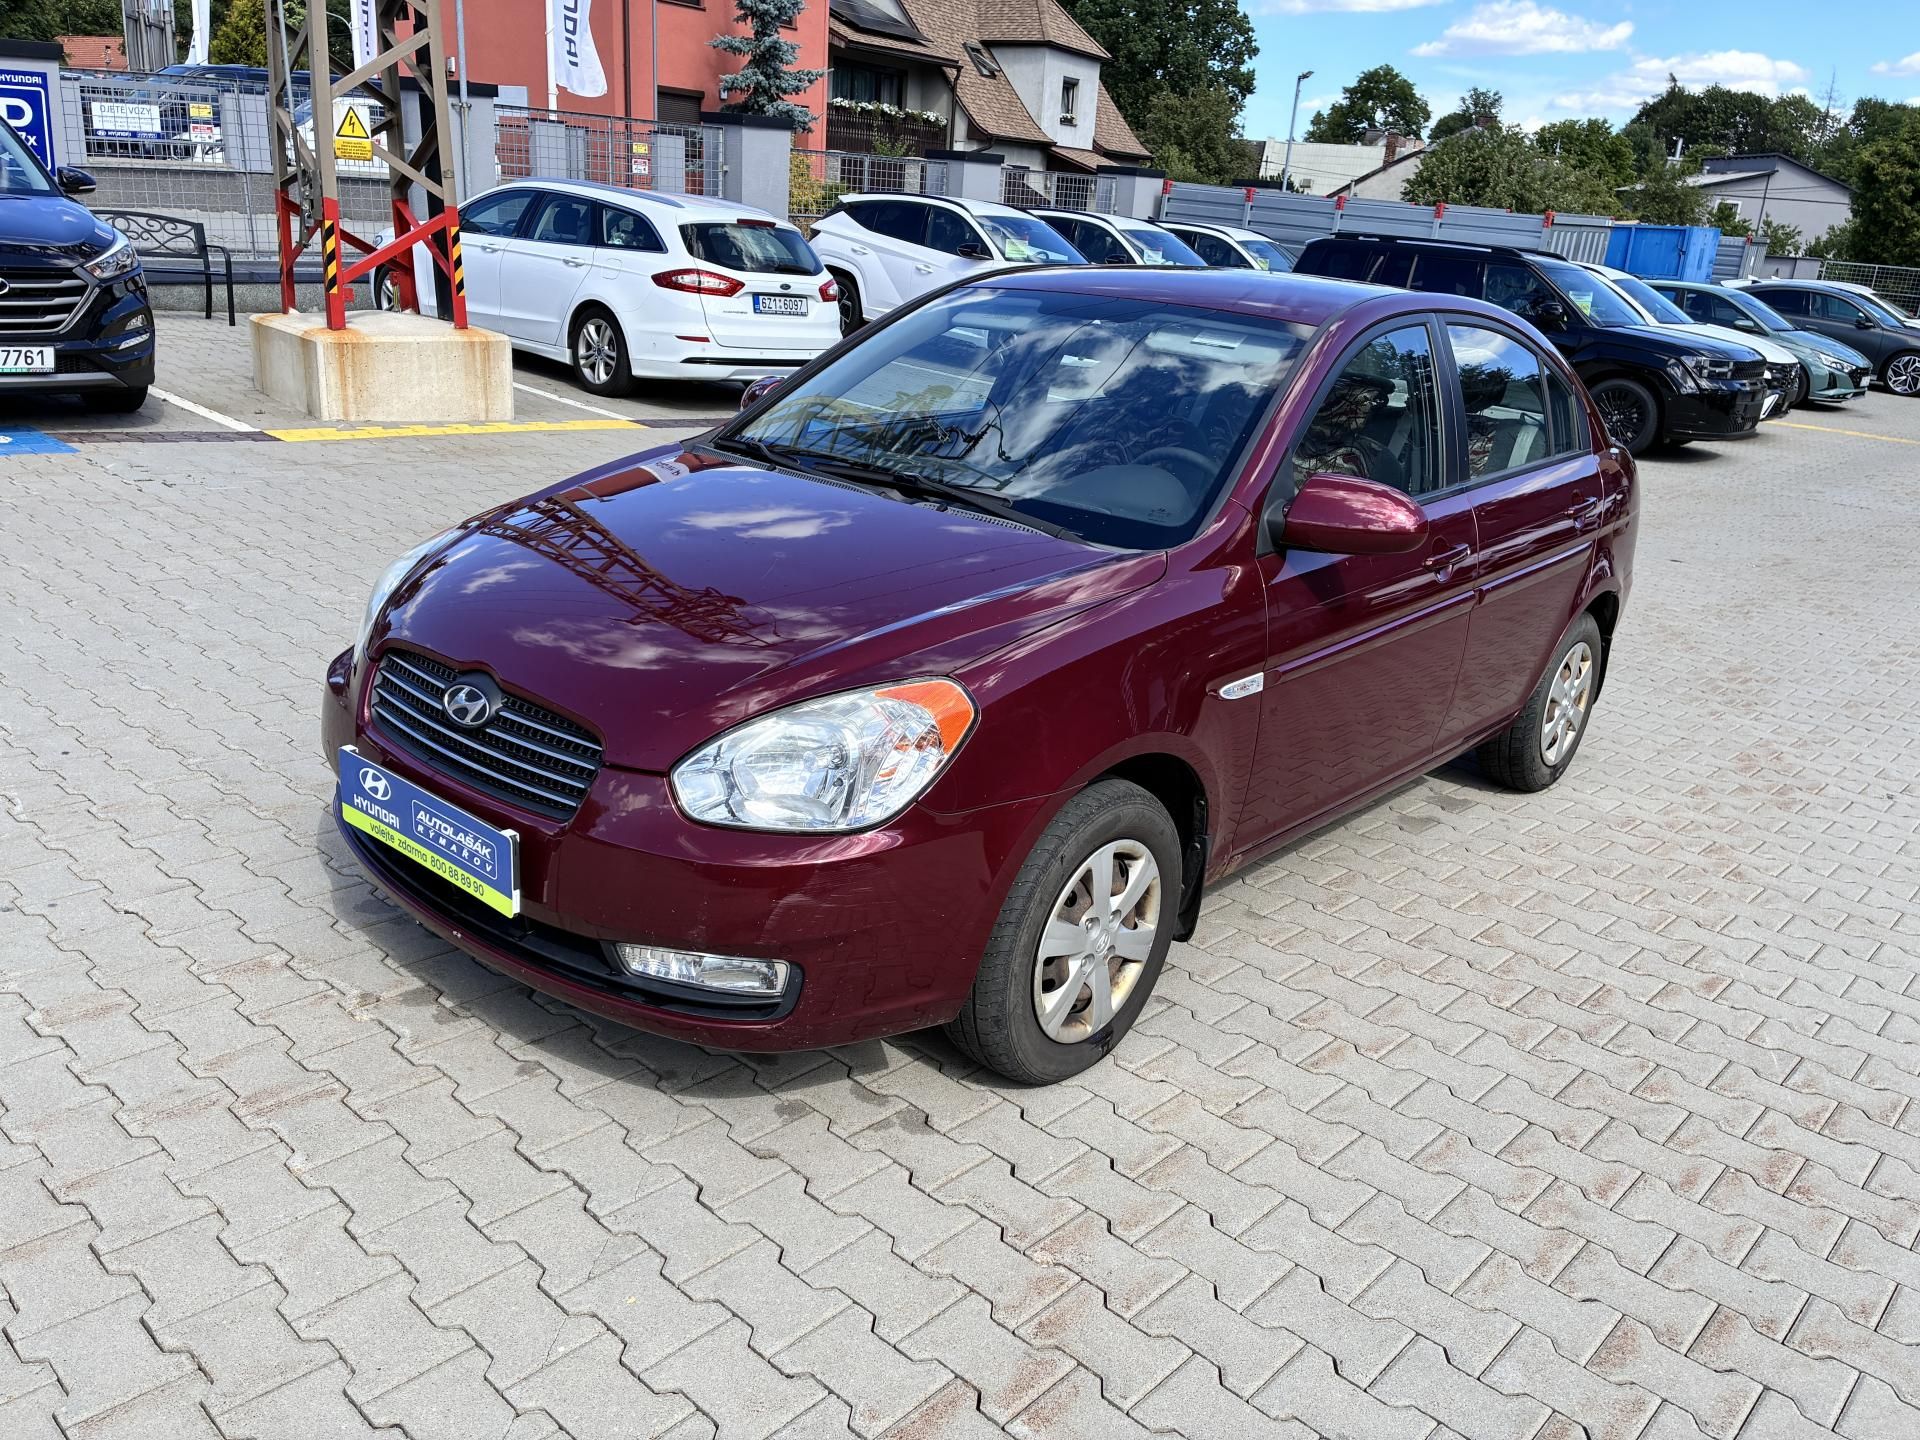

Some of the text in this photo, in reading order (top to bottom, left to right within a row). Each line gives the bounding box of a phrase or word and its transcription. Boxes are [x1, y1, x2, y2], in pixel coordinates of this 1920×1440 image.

[0, 74, 42, 84] HYUNDAI
[761, 297, 803, 311] 6Z1 6097
[0, 349, 45, 366] 7761
[353, 793, 400, 830] HYUNDAI
[416, 810, 492, 859] AUTOLAŠÁK
[370, 822, 485, 897] volejte zdarma 800 88 89 90
